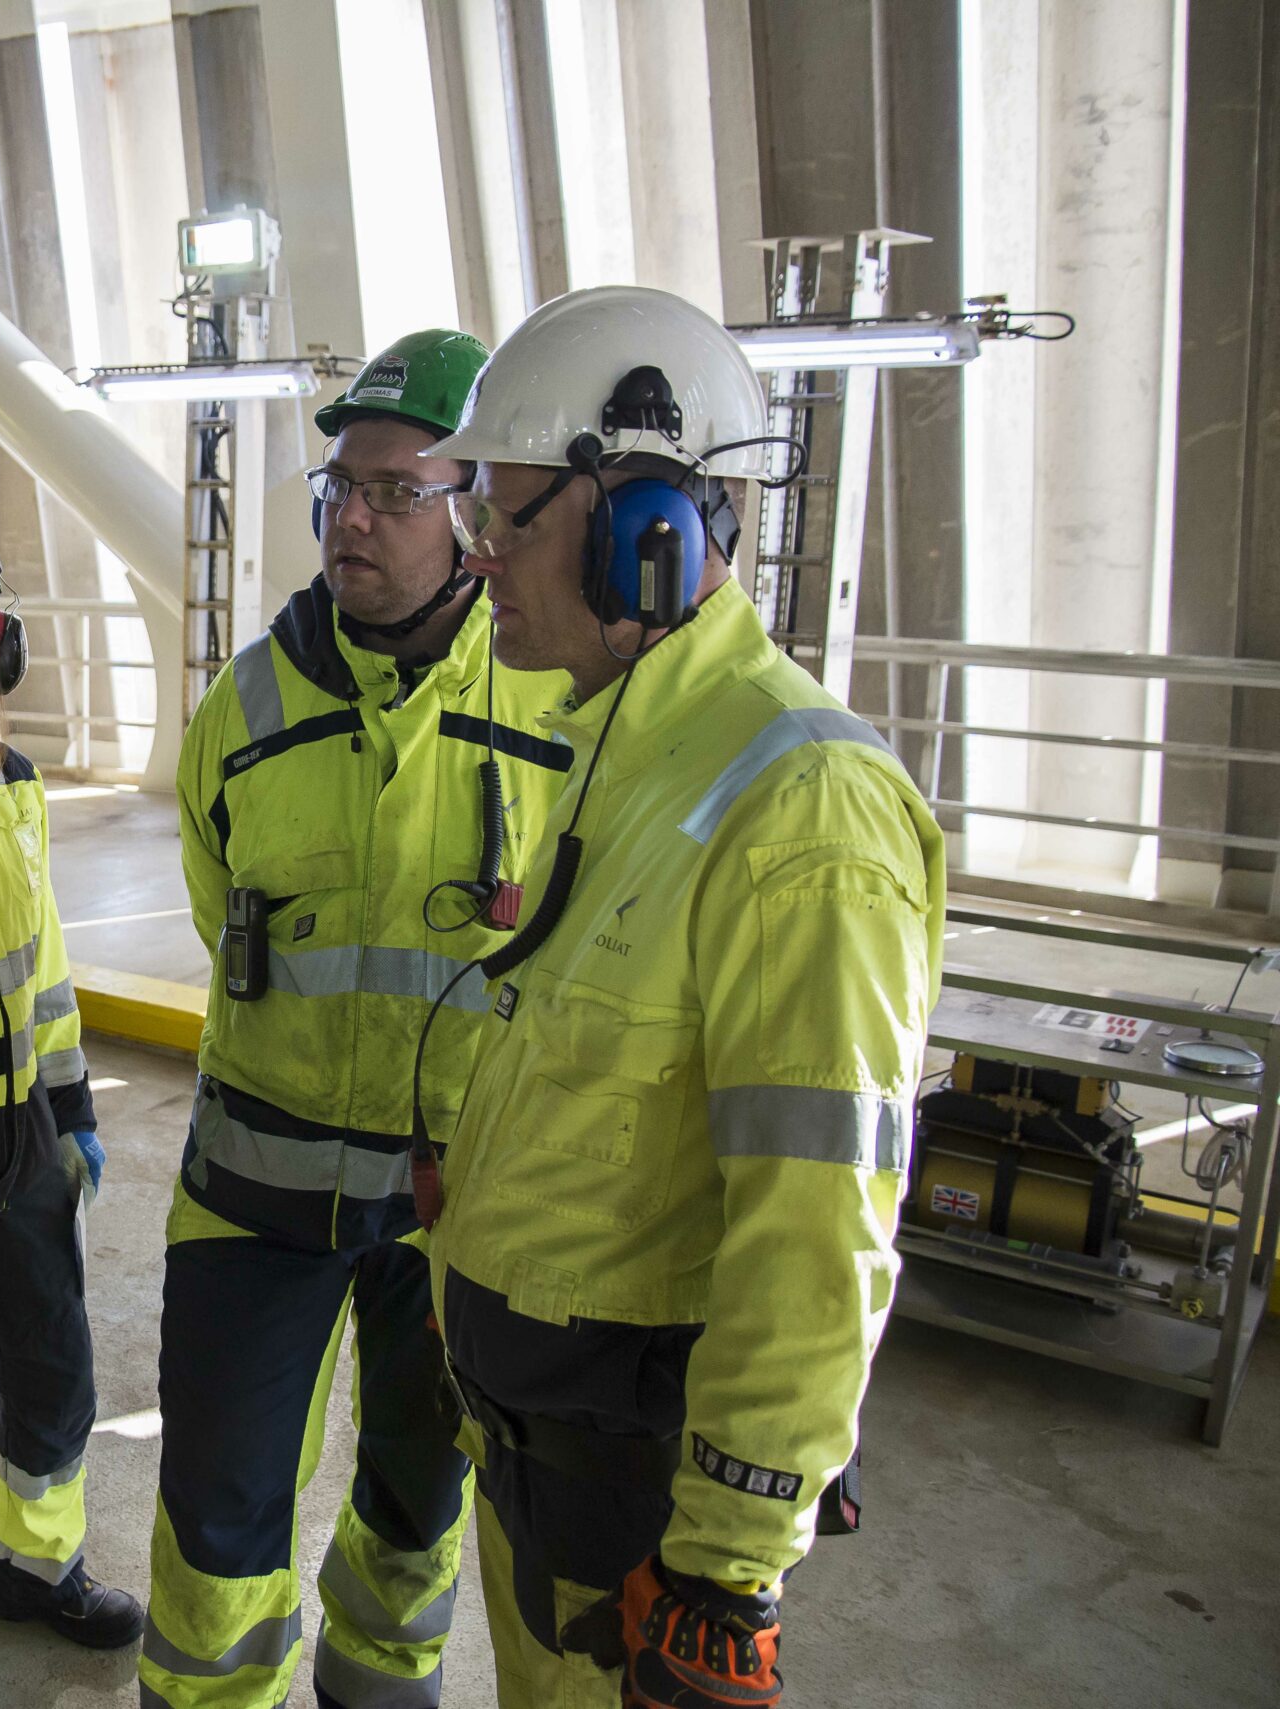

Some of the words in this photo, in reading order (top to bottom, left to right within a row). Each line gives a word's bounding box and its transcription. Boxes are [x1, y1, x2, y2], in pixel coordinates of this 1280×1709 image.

[362, 389, 393, 397] THOMAS
[504, 830, 527, 841] LIAT
[592, 934, 632, 956] OLIAT
